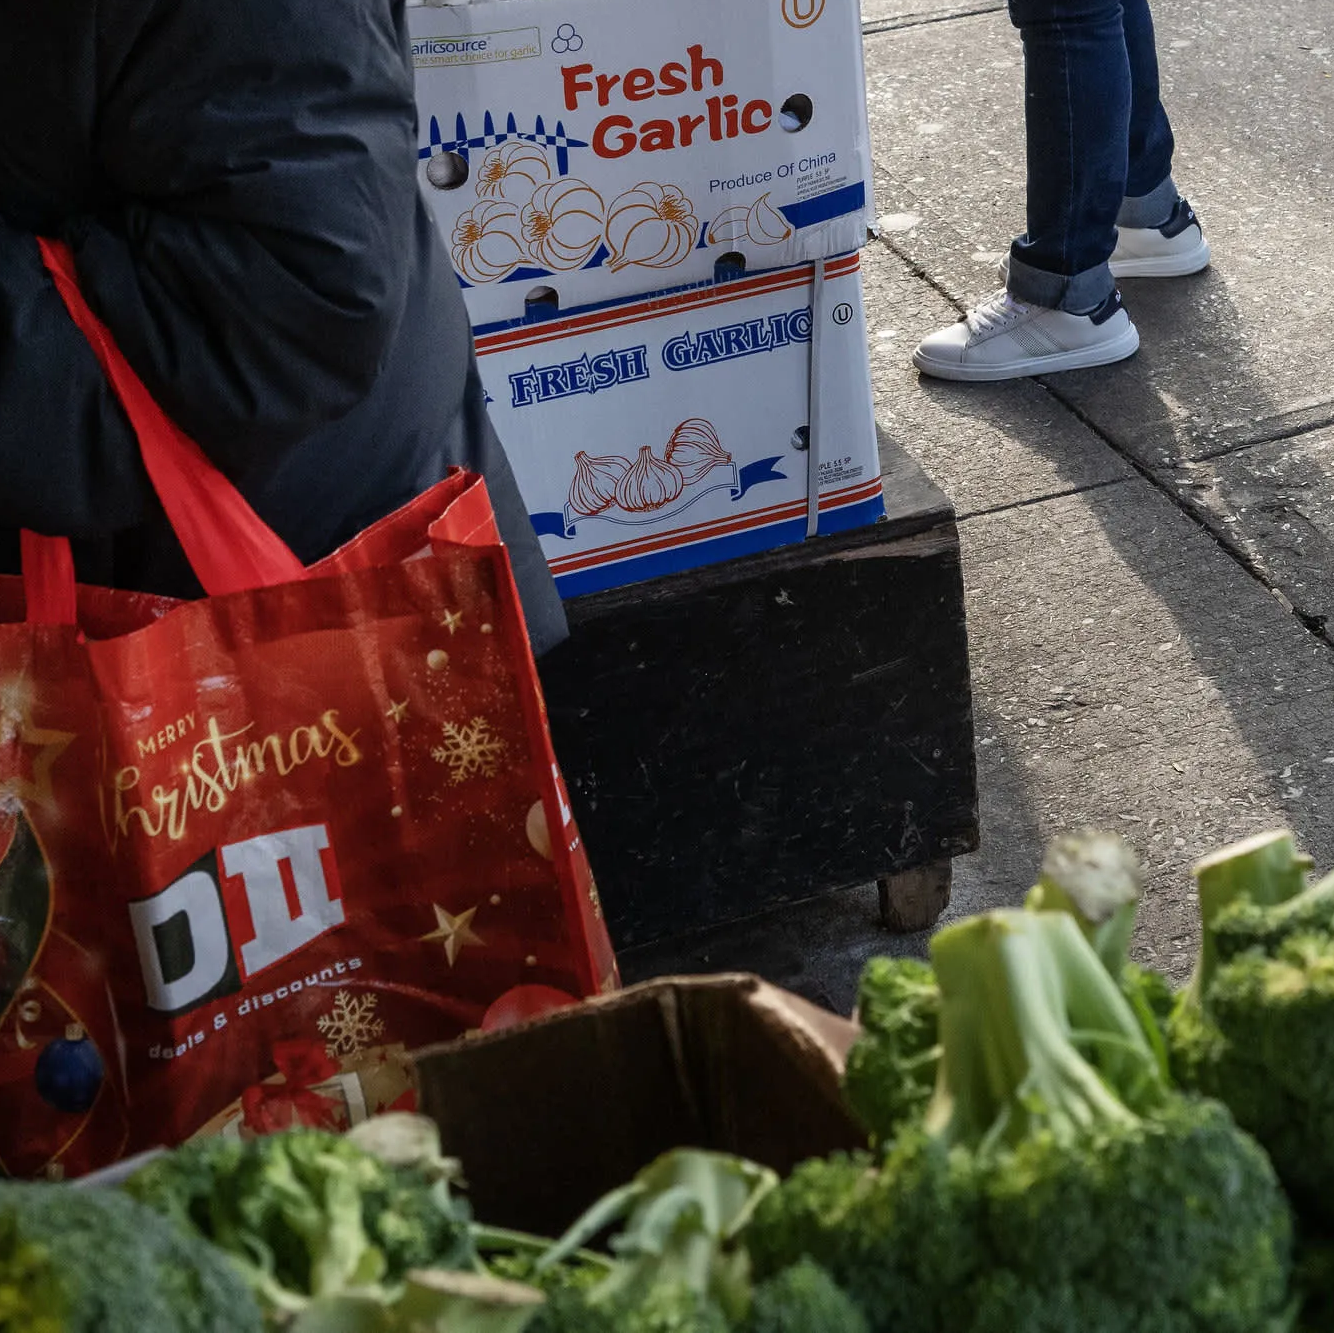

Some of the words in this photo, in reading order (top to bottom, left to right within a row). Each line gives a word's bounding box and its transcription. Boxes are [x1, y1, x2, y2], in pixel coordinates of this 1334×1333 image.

[411, 40, 487, 55] arlicsource
[430, 54, 459, 64] smart
[460, 51, 493, 63] choice
[495, 49, 508, 59] for
[509, 45, 537, 59] garlic
[560, 44, 723, 111] Fresh
[591, 94, 773, 159] Garlic
[709, 171, 772, 193] Produce
[777, 162, 795, 178] Of
[798, 152, 836, 172] China
[796, 172, 814, 184] PURPLE
[508, 344, 650, 408] FRESH
[661, 306, 813, 372] GARLIC
[136, 712, 198, 760] MERRY
[148, 1030, 207, 1060] deals
[212, 1011, 229, 1030] &
[237, 955, 364, 1016] discounts
